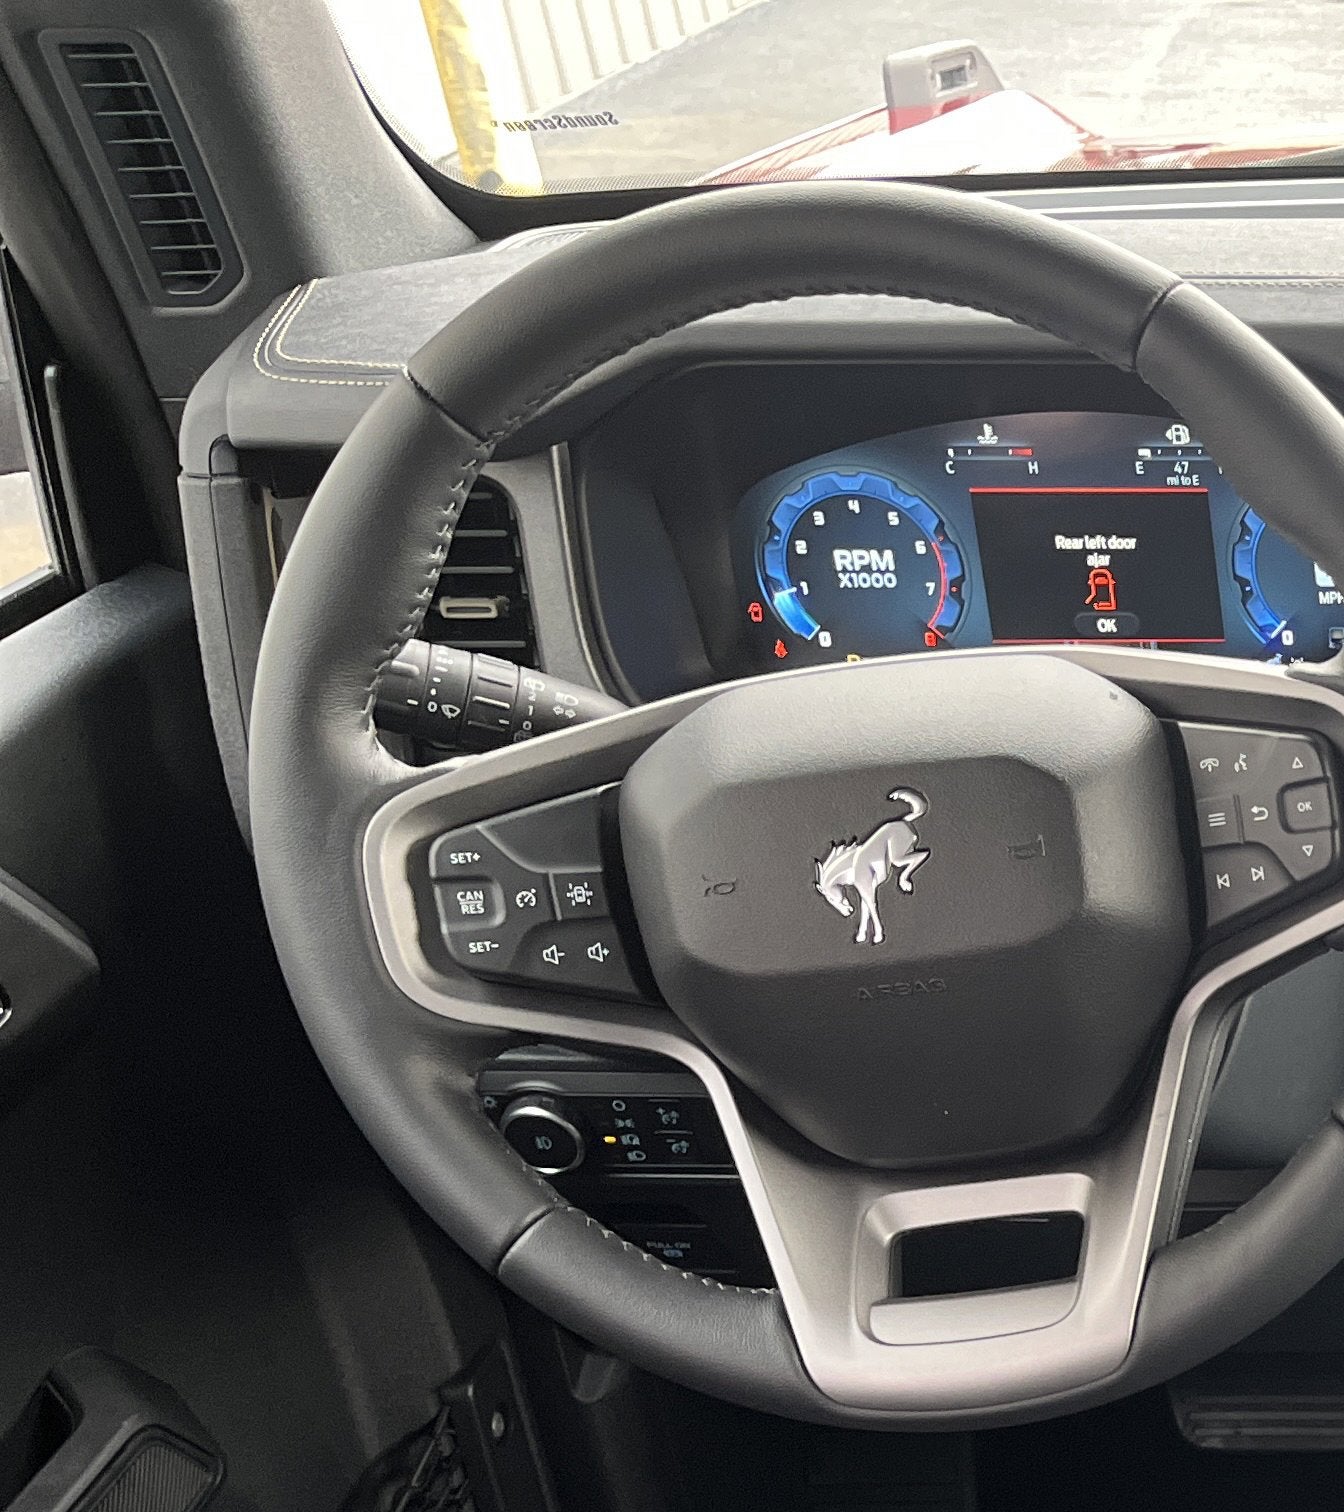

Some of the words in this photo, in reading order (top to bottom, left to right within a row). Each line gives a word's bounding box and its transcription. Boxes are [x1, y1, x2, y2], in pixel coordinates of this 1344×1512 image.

[945, 461, 956, 475] C
[1028, 461, 1039, 475] H
[1135, 461, 1145, 475] E
[1173, 461, 1189, 475] 47
[1166, 475, 1179, 486] mi
[1180, 475, 1191, 486] to
[1192, 475, 1200, 486] E
[847, 500, 860, 514] 4
[813, 511, 825, 526] 3
[887, 511, 899, 526] 5
[795, 540, 808, 555] 2
[915, 540, 927, 555] 6
[1054, 535, 1083, 550] Rear
[1084, 535, 1106, 550] left
[1107, 535, 1137, 550] door
[833, 549, 896, 572] RPM
[1087, 553, 1111, 568] ajar
[838, 572, 898, 589] X1000
[799, 582, 809, 596] 1
[925, 582, 936, 596] 7
[1097, 619, 1118, 634] OK
[818, 631, 832, 647] 0
[1281, 630, 1294, 646] 0
[1296, 801, 1313, 813] OK
[450, 852, 481, 864] SET+
[456, 890, 484, 902] CAN
[460, 902, 485, 915] RES
